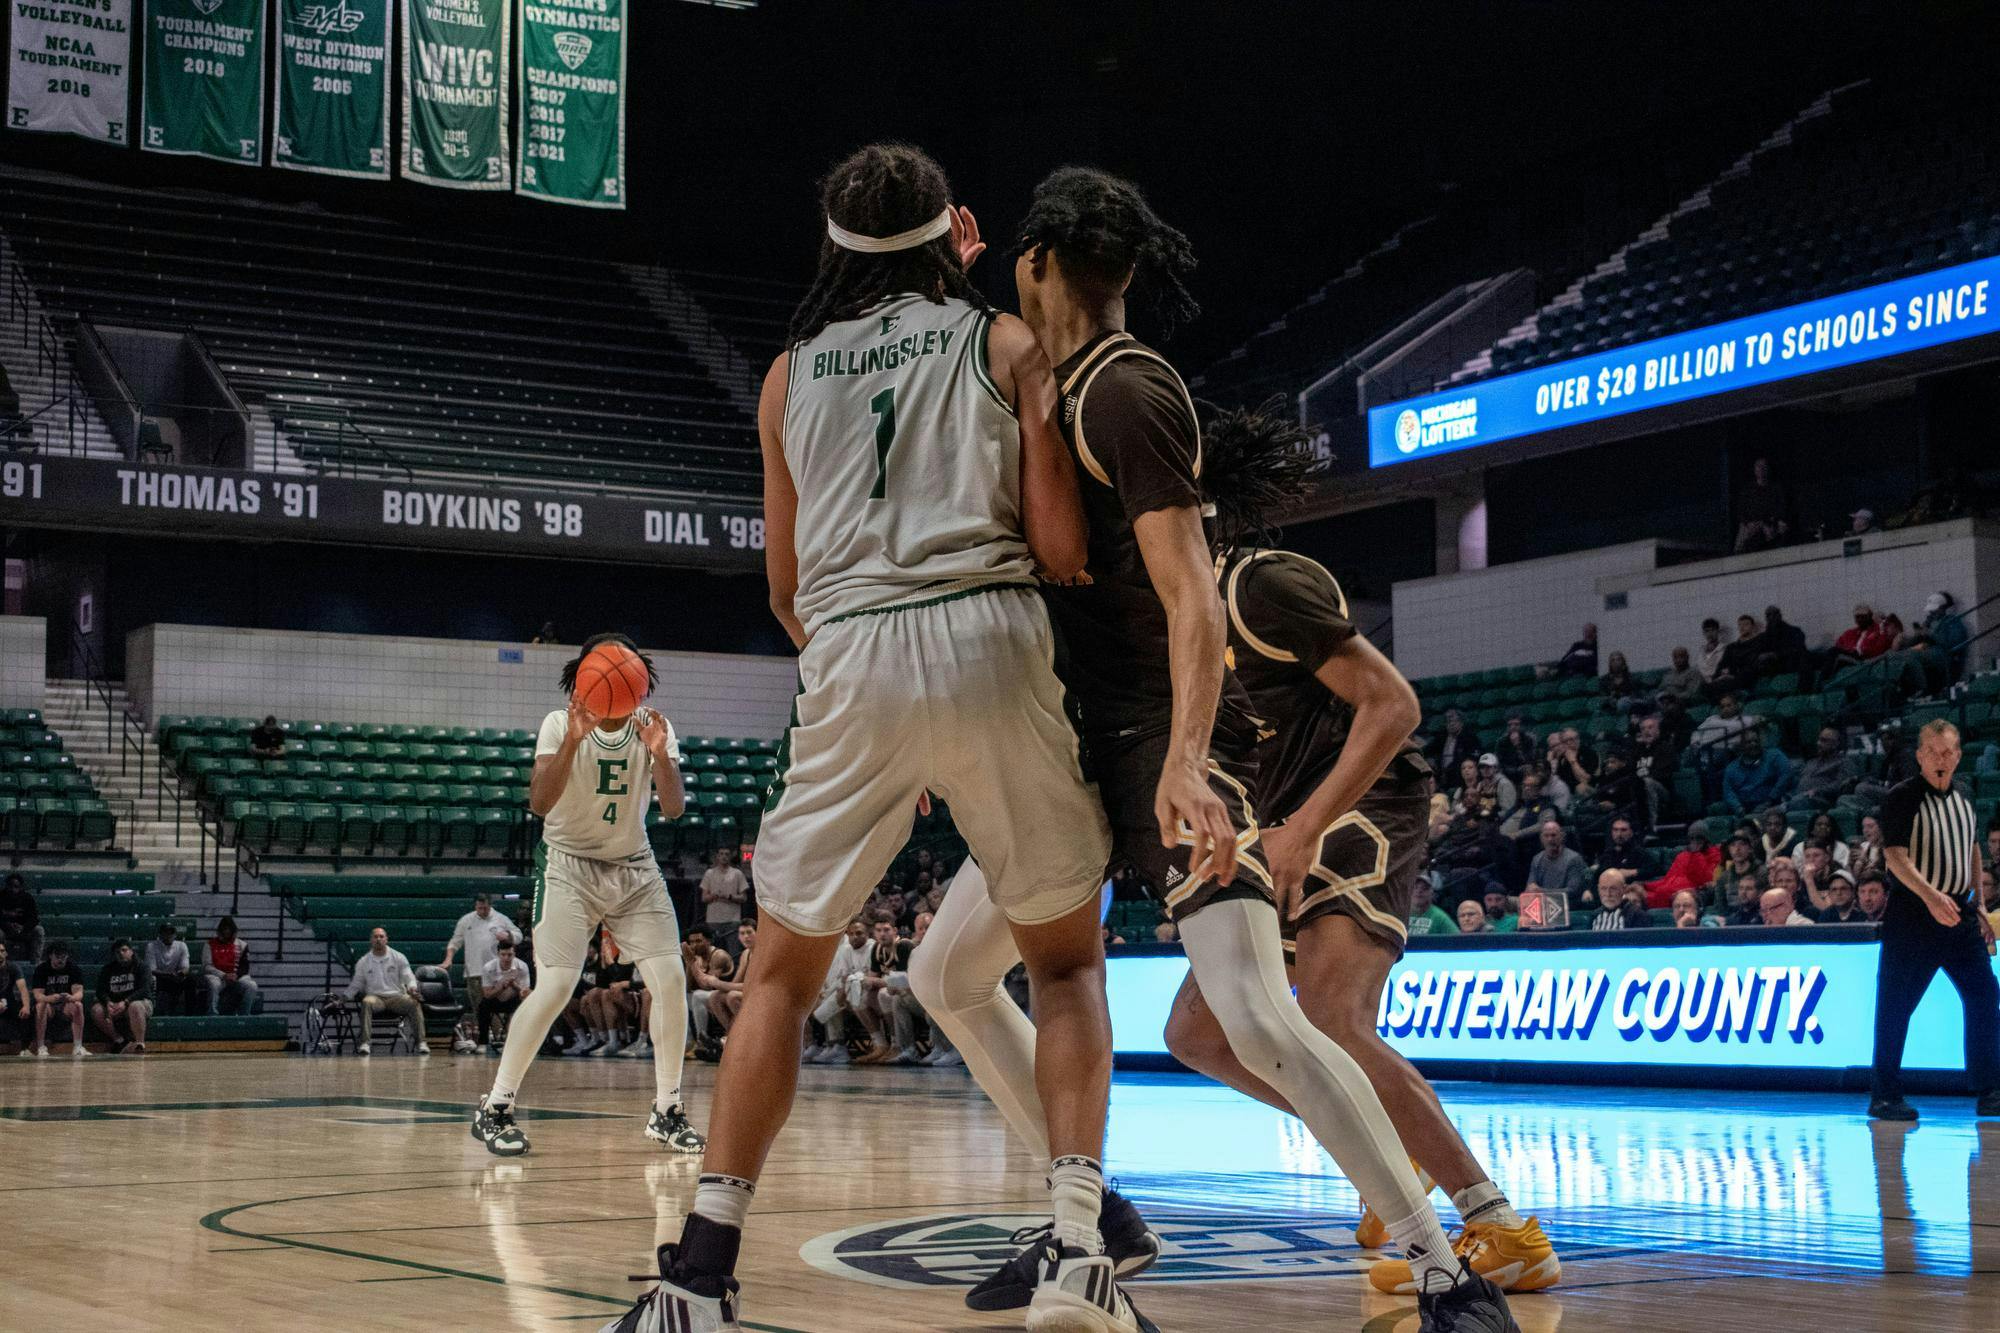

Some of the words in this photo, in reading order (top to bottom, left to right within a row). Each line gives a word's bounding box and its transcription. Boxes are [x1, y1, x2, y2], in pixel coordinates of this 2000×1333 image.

[17, 3, 126, 33] VOLLEYBALL
[156, 15, 254, 42] TOURNAMENT
[426, 5, 486, 28] VOLLEYBALL
[525, 5, 620, 32] GYMNASTICS
[45, 35, 95, 56] NCAA
[164, 33, 245, 57] CHAMPIONS
[283, 33, 321, 52] WEST
[326, 40, 384, 60] DIVISION
[18, 49, 122, 76] TOURNAMENT
[295, 52, 372, 75] CHAMPIONS
[416, 79, 498, 107] TOURNAMENT
[527, 66, 617, 95] CHAMPIONS
[530, 85, 567, 105] 2007
[11, 107, 29, 127] E
[107, 121, 123, 140] E
[148, 125, 164, 146] E
[529, 124, 566, 143] 2017
[239, 138, 255, 159] E
[527, 142, 565, 162] 2021
[880, 316, 901, 336] E
[812, 329, 955, 382] BILLINGSLEY
[1536, 375, 1590, 415] OVER
[1597, 364, 1637, 406] $28
[1644, 341, 1736, 391] BILLION
[1745, 332, 1773, 368] TO
[1781, 303, 1897, 359] SCHOOLS
[1907, 280, 1989, 331] SINCE
[868, 384, 897, 499] 1
[1421, 416, 1478, 447] LOTTERY
[0, 462, 42, 499] 91
[117, 470, 260, 514] THOMAS
[273, 482, 318, 519] '91
[382, 490, 521, 533] BOYKINS
[535, 501, 583, 537] '98
[644, 510, 710, 546] DIAL
[721, 515, 766, 550] '98
[595, 758, 628, 795] E
[602, 802, 617, 825] 4
[1376, 968, 1608, 1040] SHTENAW
[1613, 966, 1827, 1044] COUNTY.
